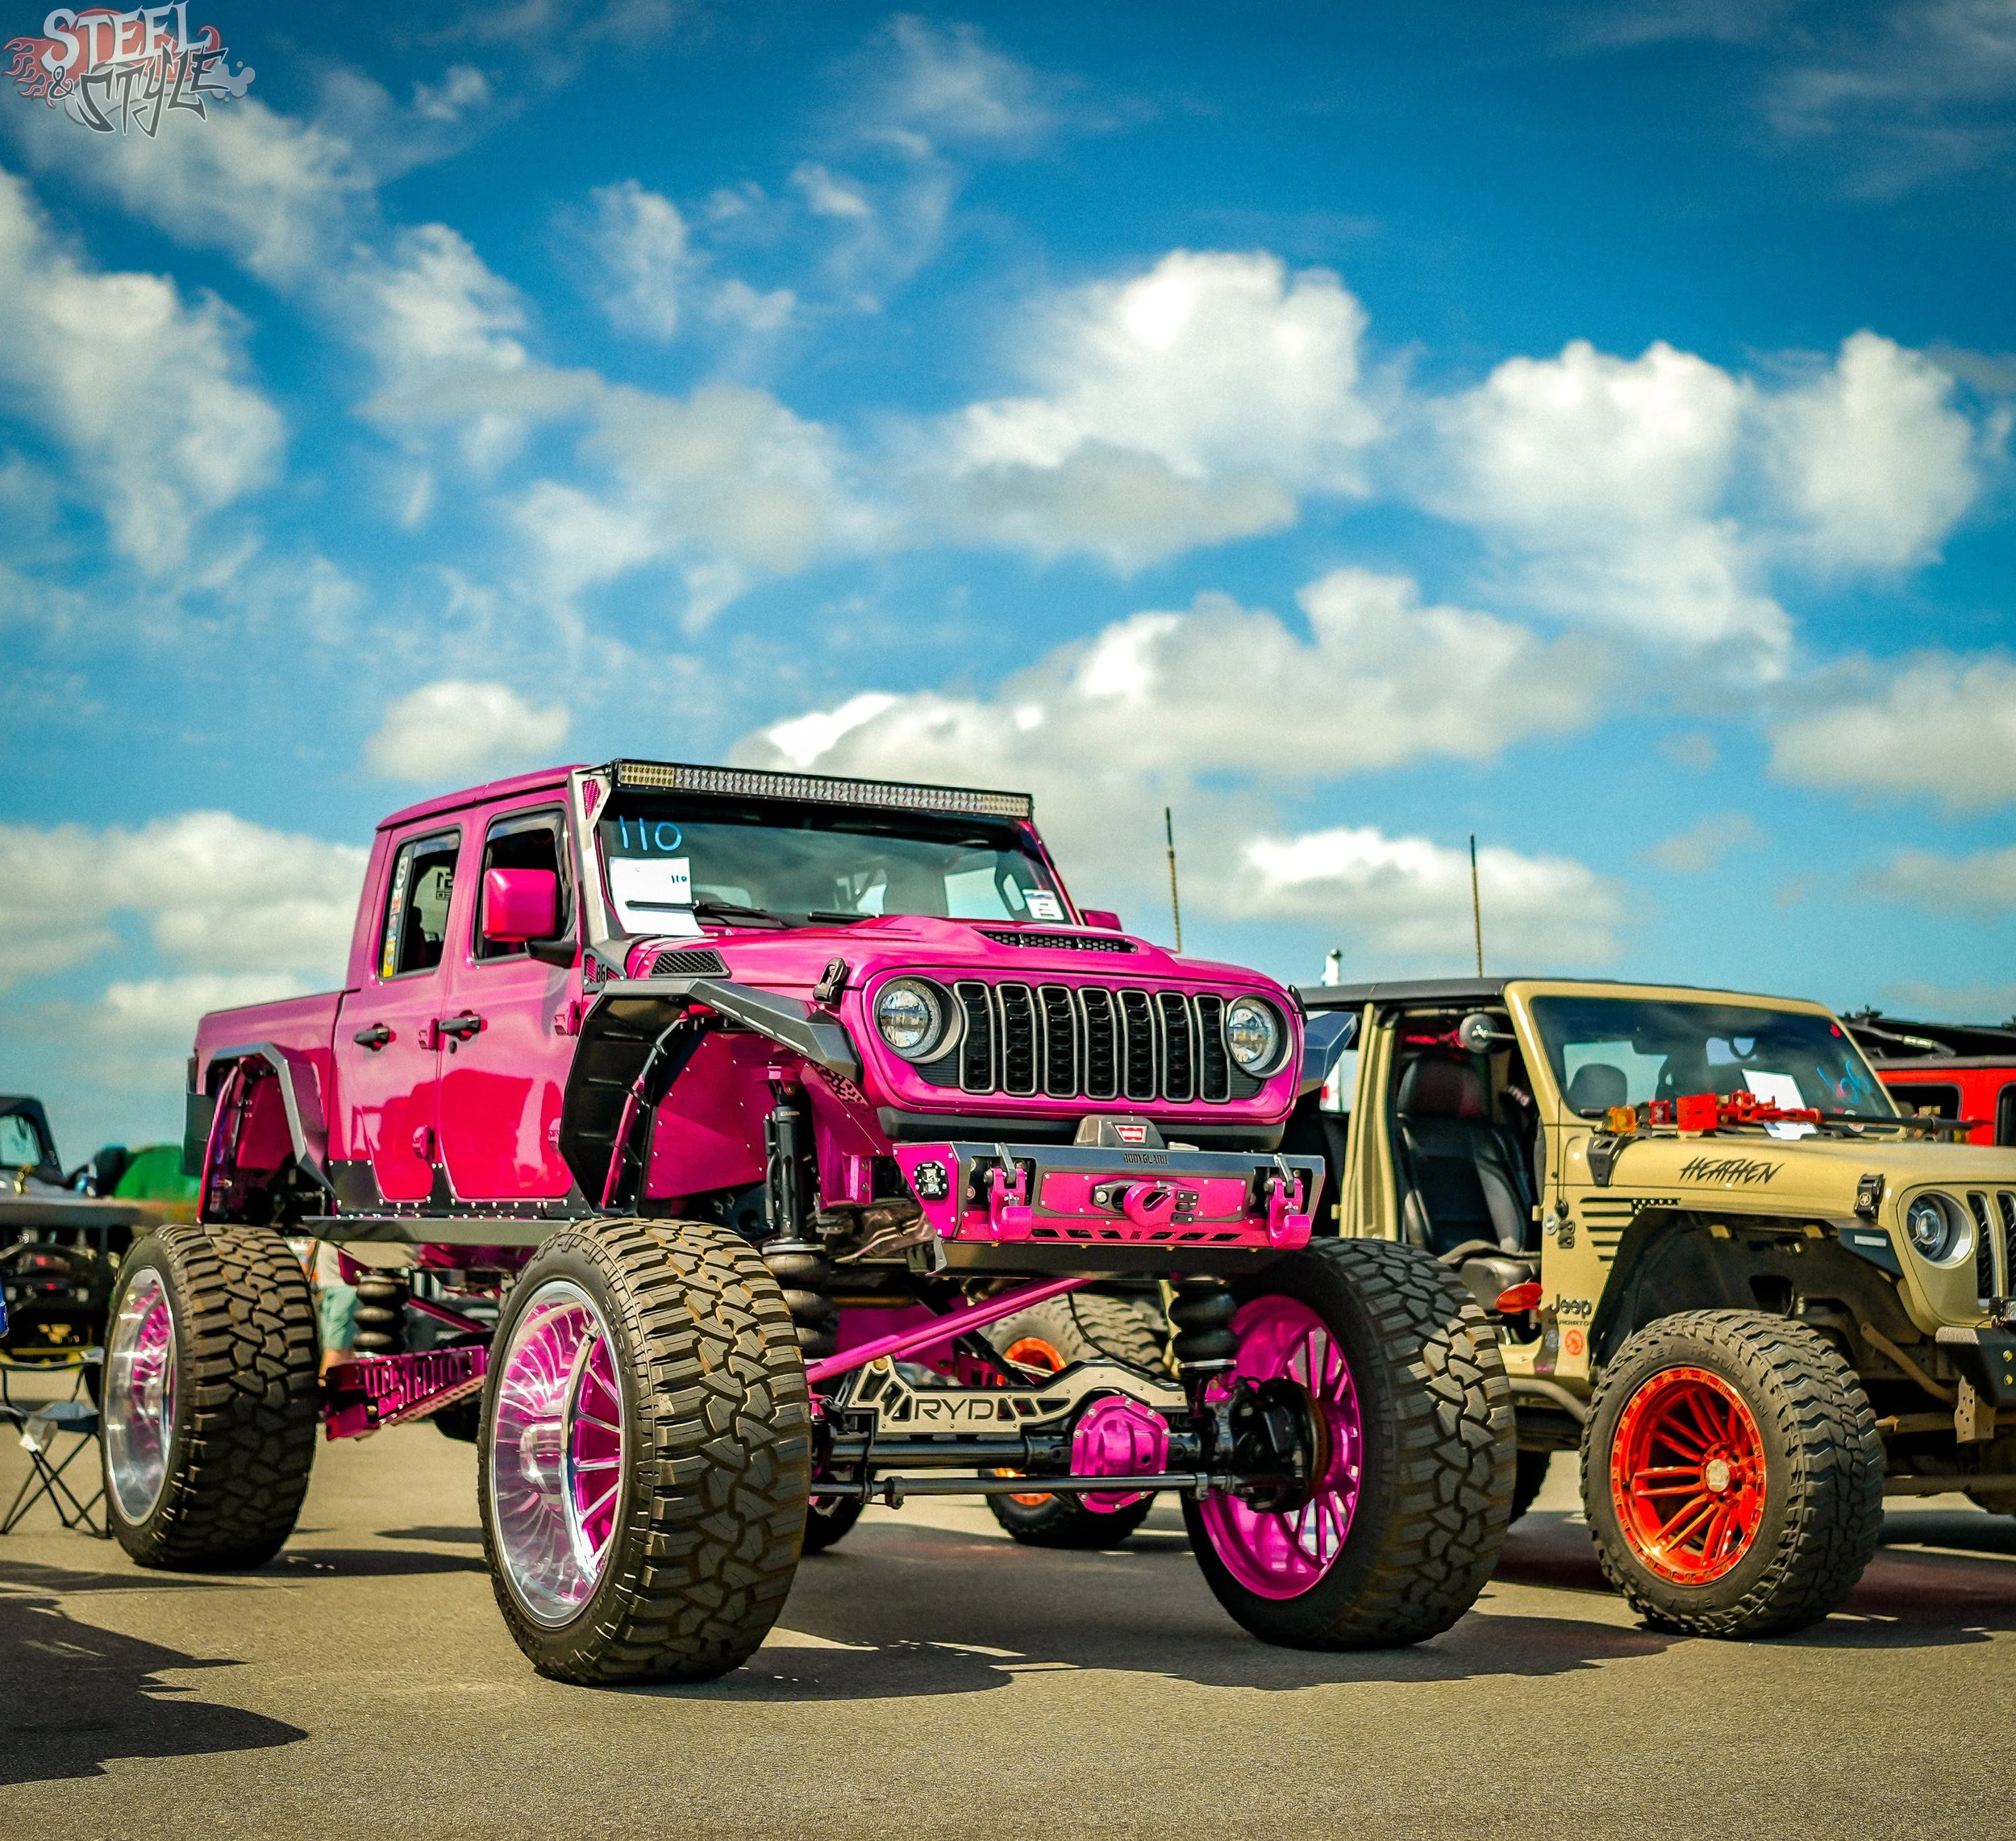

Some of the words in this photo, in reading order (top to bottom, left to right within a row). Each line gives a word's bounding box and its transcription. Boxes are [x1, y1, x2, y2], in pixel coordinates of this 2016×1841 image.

[619, 814, 682, 851] 110
[671, 875, 688, 884] 110
[1123, 1153, 1168, 1164] BODYGUARD
[1678, 1156, 1785, 1185] HEATHEN
[1549, 1293, 1593, 1318] Jeep
[914, 1398, 994, 1420] RYD
